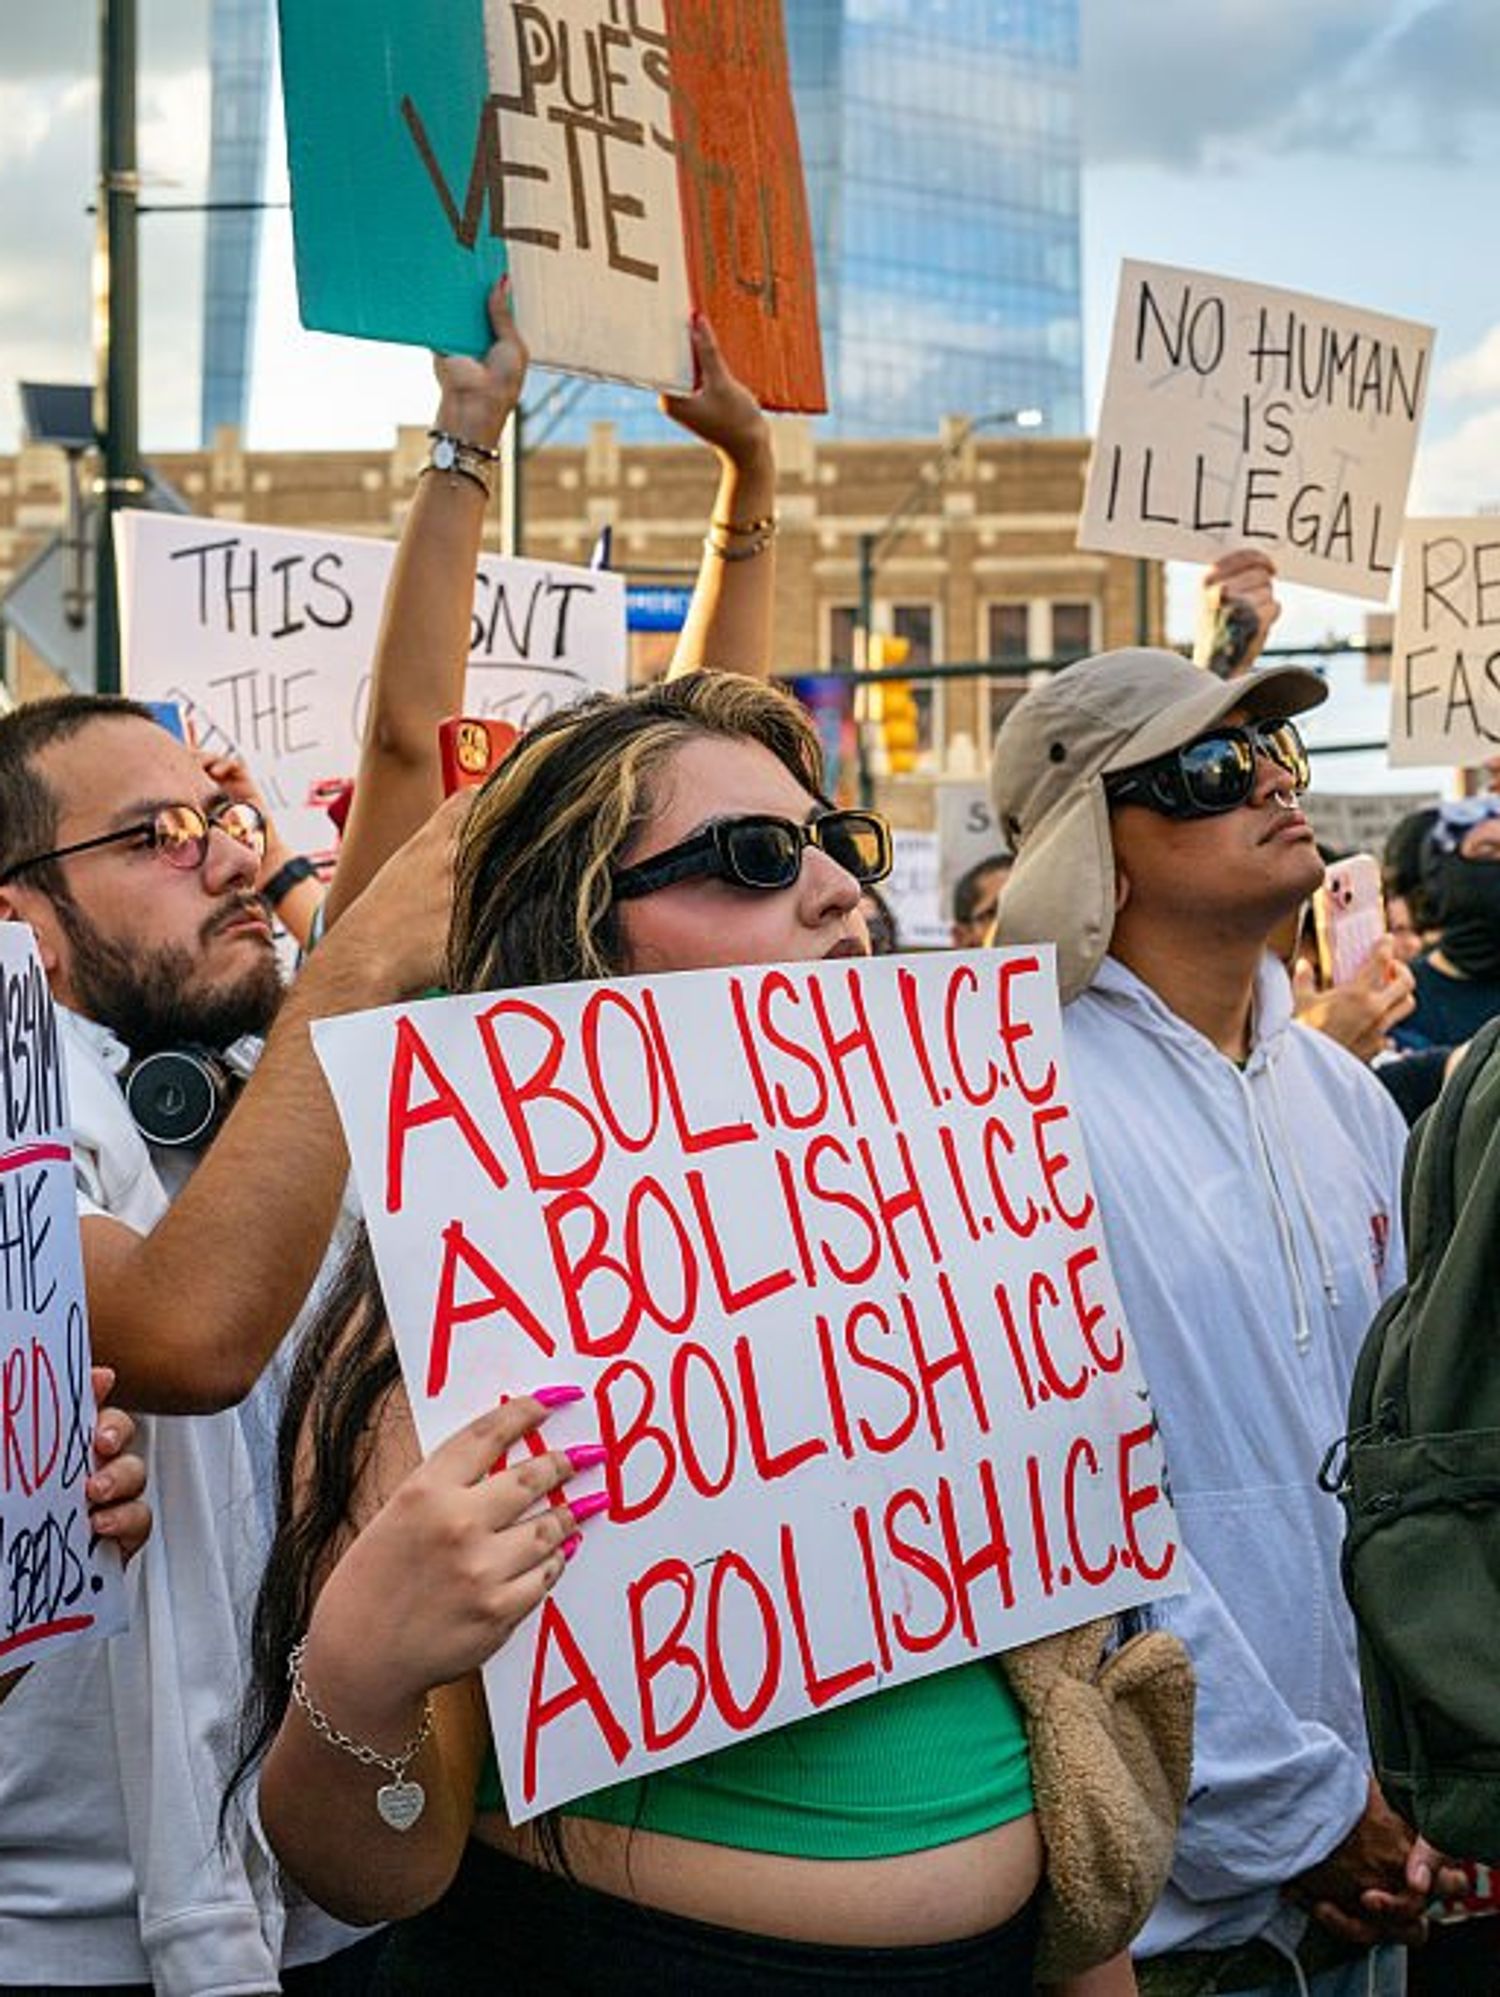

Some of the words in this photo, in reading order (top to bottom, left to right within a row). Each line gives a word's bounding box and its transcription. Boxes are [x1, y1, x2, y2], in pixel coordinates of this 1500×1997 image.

[402, 94, 661, 282] VETE
[1136, 281, 1225, 375] NO
[1249, 307, 1425, 422] HUMAN
[1243, 395, 1294, 457] IS
[1106, 445, 1392, 572] ILLEGAL
[170, 539, 354, 639] THIS
[209, 668, 320, 758] THE
[386, 968, 898, 1214] ABOLISH
[899, 957, 1056, 1107] I.C.E
[427, 1132, 941, 1397] ABOLISH
[939, 1106, 1094, 1241] I.C.E
[994, 1246, 1124, 1407] I.C.E
[523, 1459, 1016, 1802] ABOLISH
[1027, 1425, 1176, 1600] I.C.E
